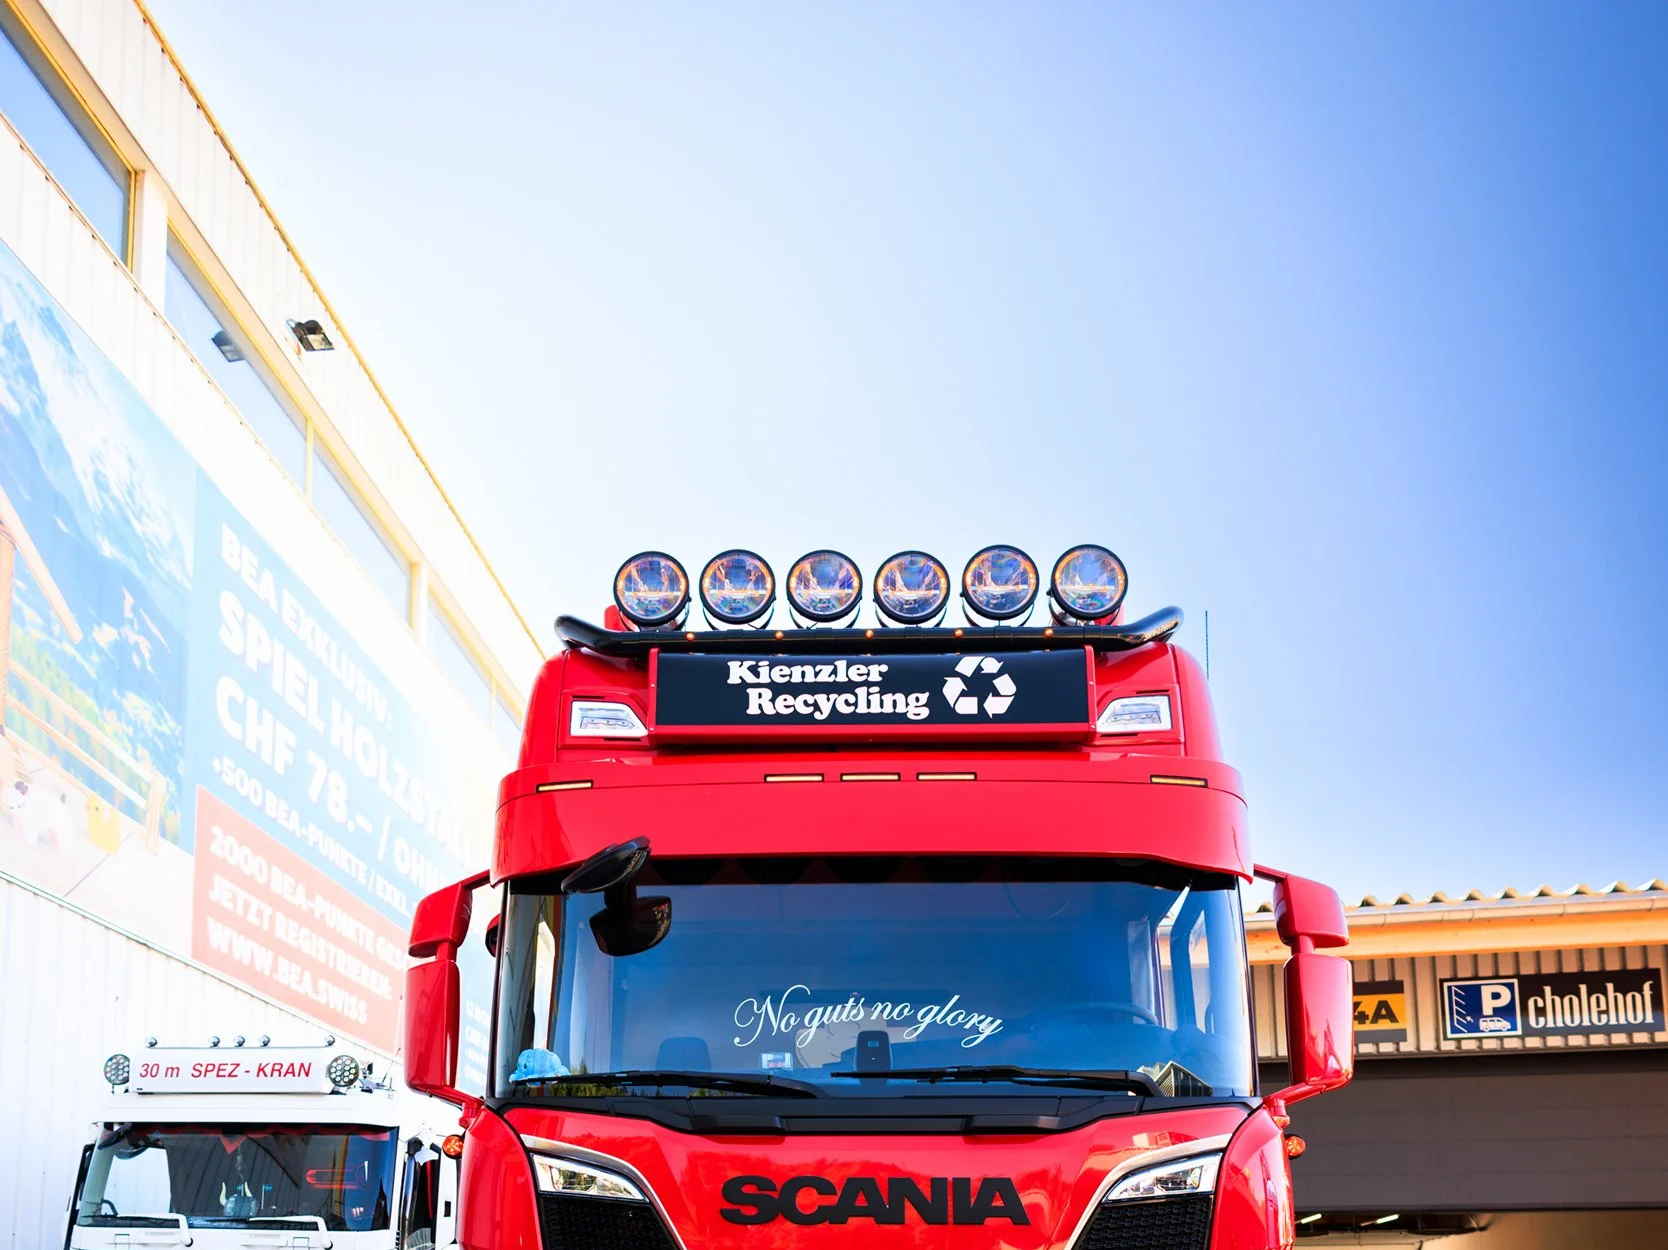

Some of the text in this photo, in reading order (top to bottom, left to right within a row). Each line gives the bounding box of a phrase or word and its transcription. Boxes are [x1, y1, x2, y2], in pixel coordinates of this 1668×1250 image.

[221, 521, 393, 732] BEA EXKLUSIV:
[218, 589, 326, 735] SPIEL
[727, 660, 888, 684] Kienzler
[215, 675, 297, 777] CHF
[746, 686, 930, 720] Recycling
[265, 789, 367, 886] BEA-PUNKTE
[207, 873, 275, 932] JETZT
[209, 825, 268, 885] 2000
[269, 864, 375, 954] BEA-PUNKTE
[206, 916, 368, 1025] WWW.BEA.SWISS
[1480, 984, 1512, 1016] P
[734, 984, 1004, 1048] No guts no glory
[1527, 980, 1655, 1029] cholehof
[139, 1063, 160, 1078] 30
[164, 1066, 180, 1078] m
[191, 1062, 241, 1078] SPEZ
[256, 1062, 312, 1078] KRAN
[720, 1175, 1031, 1226] SCANIA
